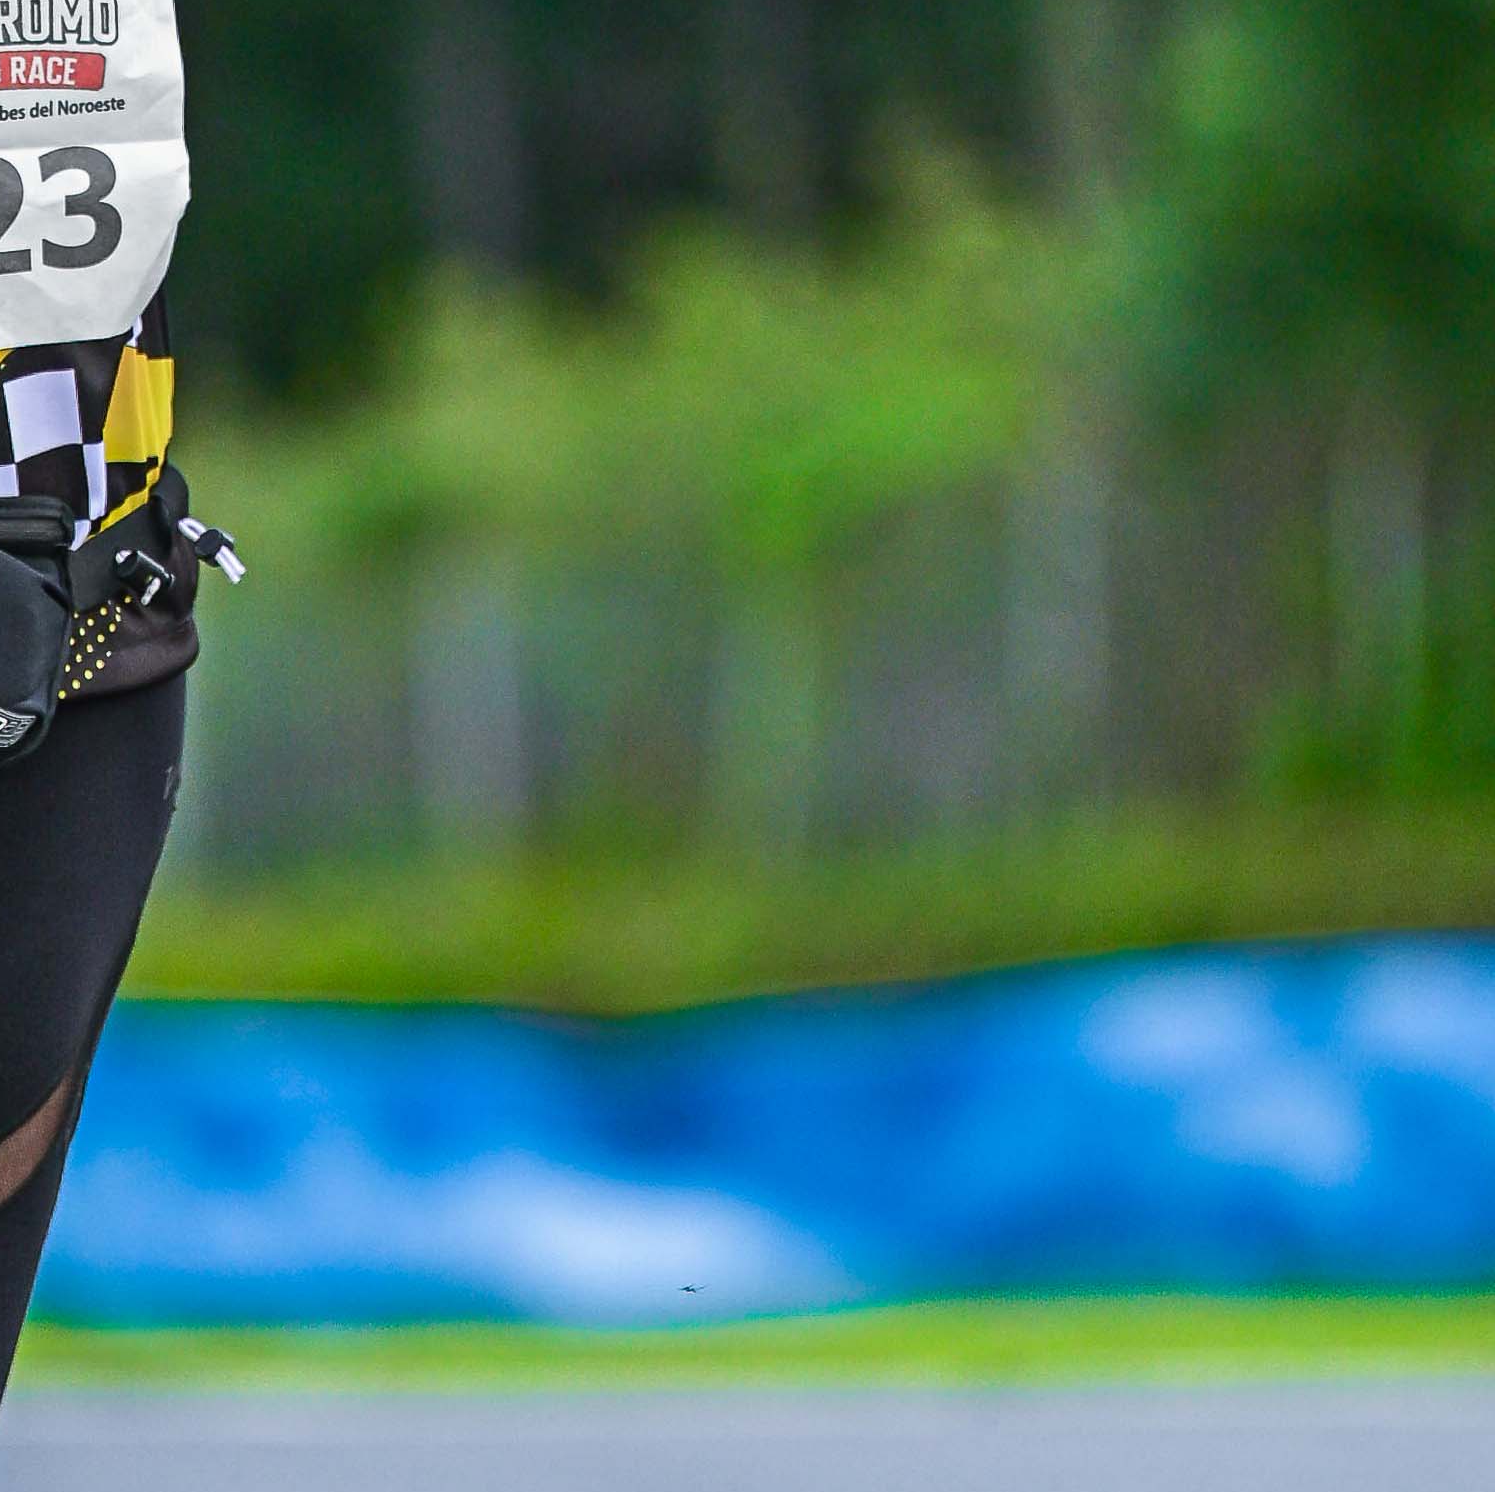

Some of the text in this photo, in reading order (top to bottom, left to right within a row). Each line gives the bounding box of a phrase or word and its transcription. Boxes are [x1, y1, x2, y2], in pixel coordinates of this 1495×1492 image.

[9, 54, 77, 87] RACE
[30, 100, 54, 120] del
[57, 96, 126, 116] Noroeste
